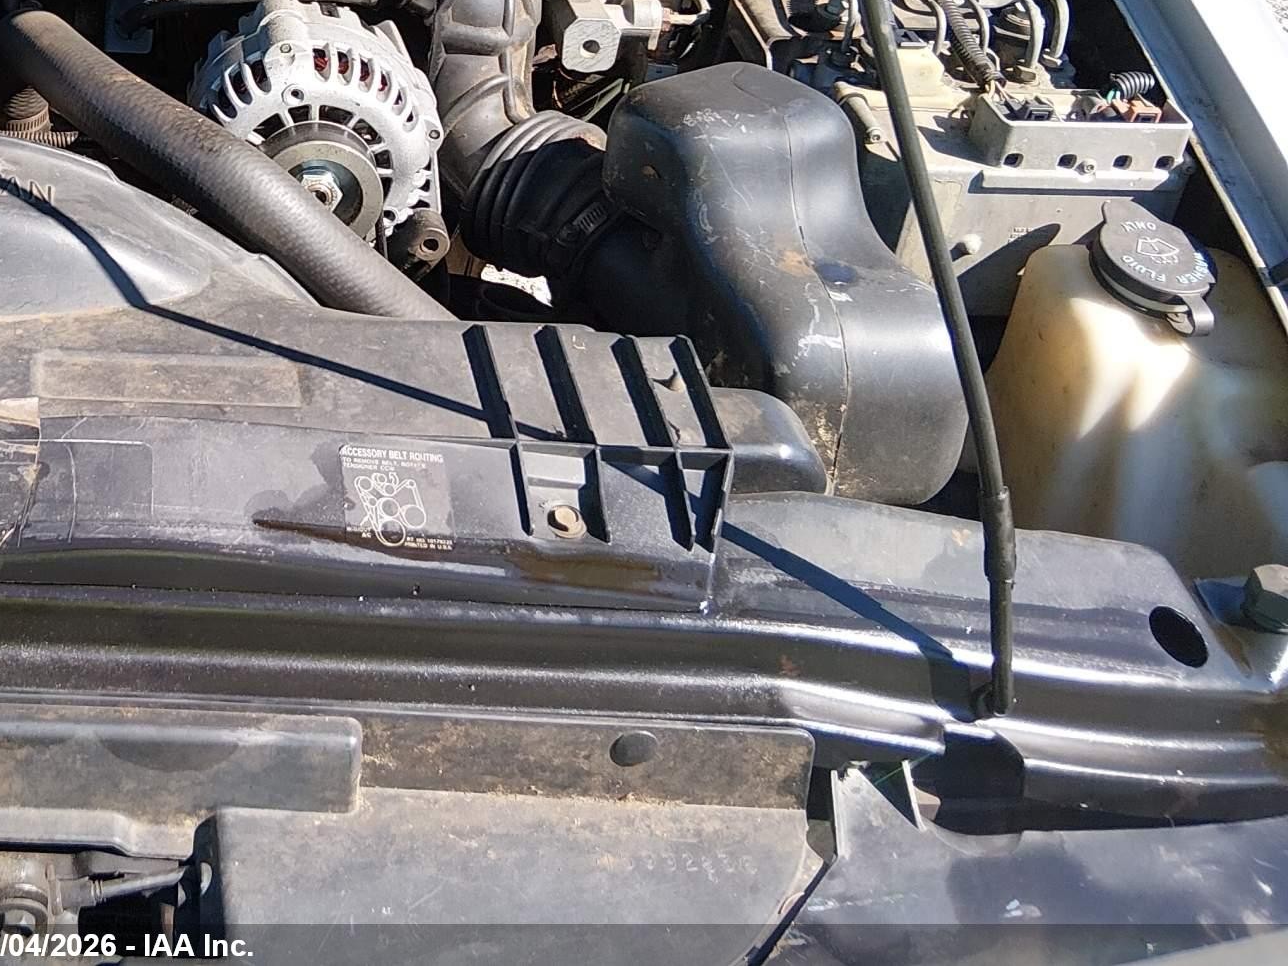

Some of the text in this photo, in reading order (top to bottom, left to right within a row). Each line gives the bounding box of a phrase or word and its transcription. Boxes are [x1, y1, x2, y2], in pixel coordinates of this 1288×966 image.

[1121, 220, 1158, 234] ONLY
[1121, 251, 1210, 285] WASHER FLUID
[340, 445, 444, 464] ACCESSORY BELT ROUTING
